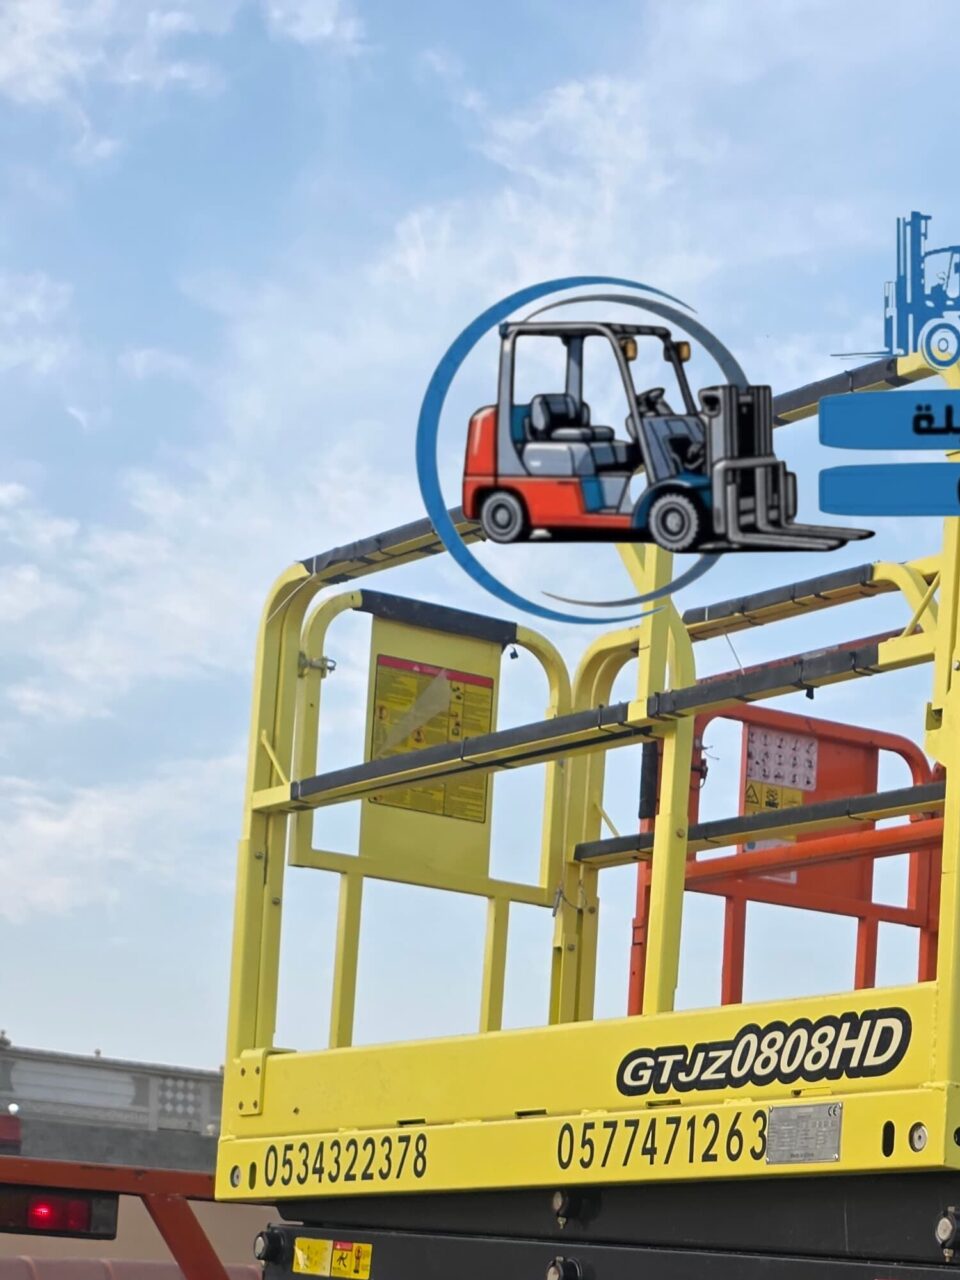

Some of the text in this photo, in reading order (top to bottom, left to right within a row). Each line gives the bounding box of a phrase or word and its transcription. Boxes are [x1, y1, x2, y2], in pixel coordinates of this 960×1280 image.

[621, 1016, 904, 1088] GTJZ0808HD
[264, 1133, 428, 1187] 0534322378
[557, 1109, 768, 1170] 0577471263
